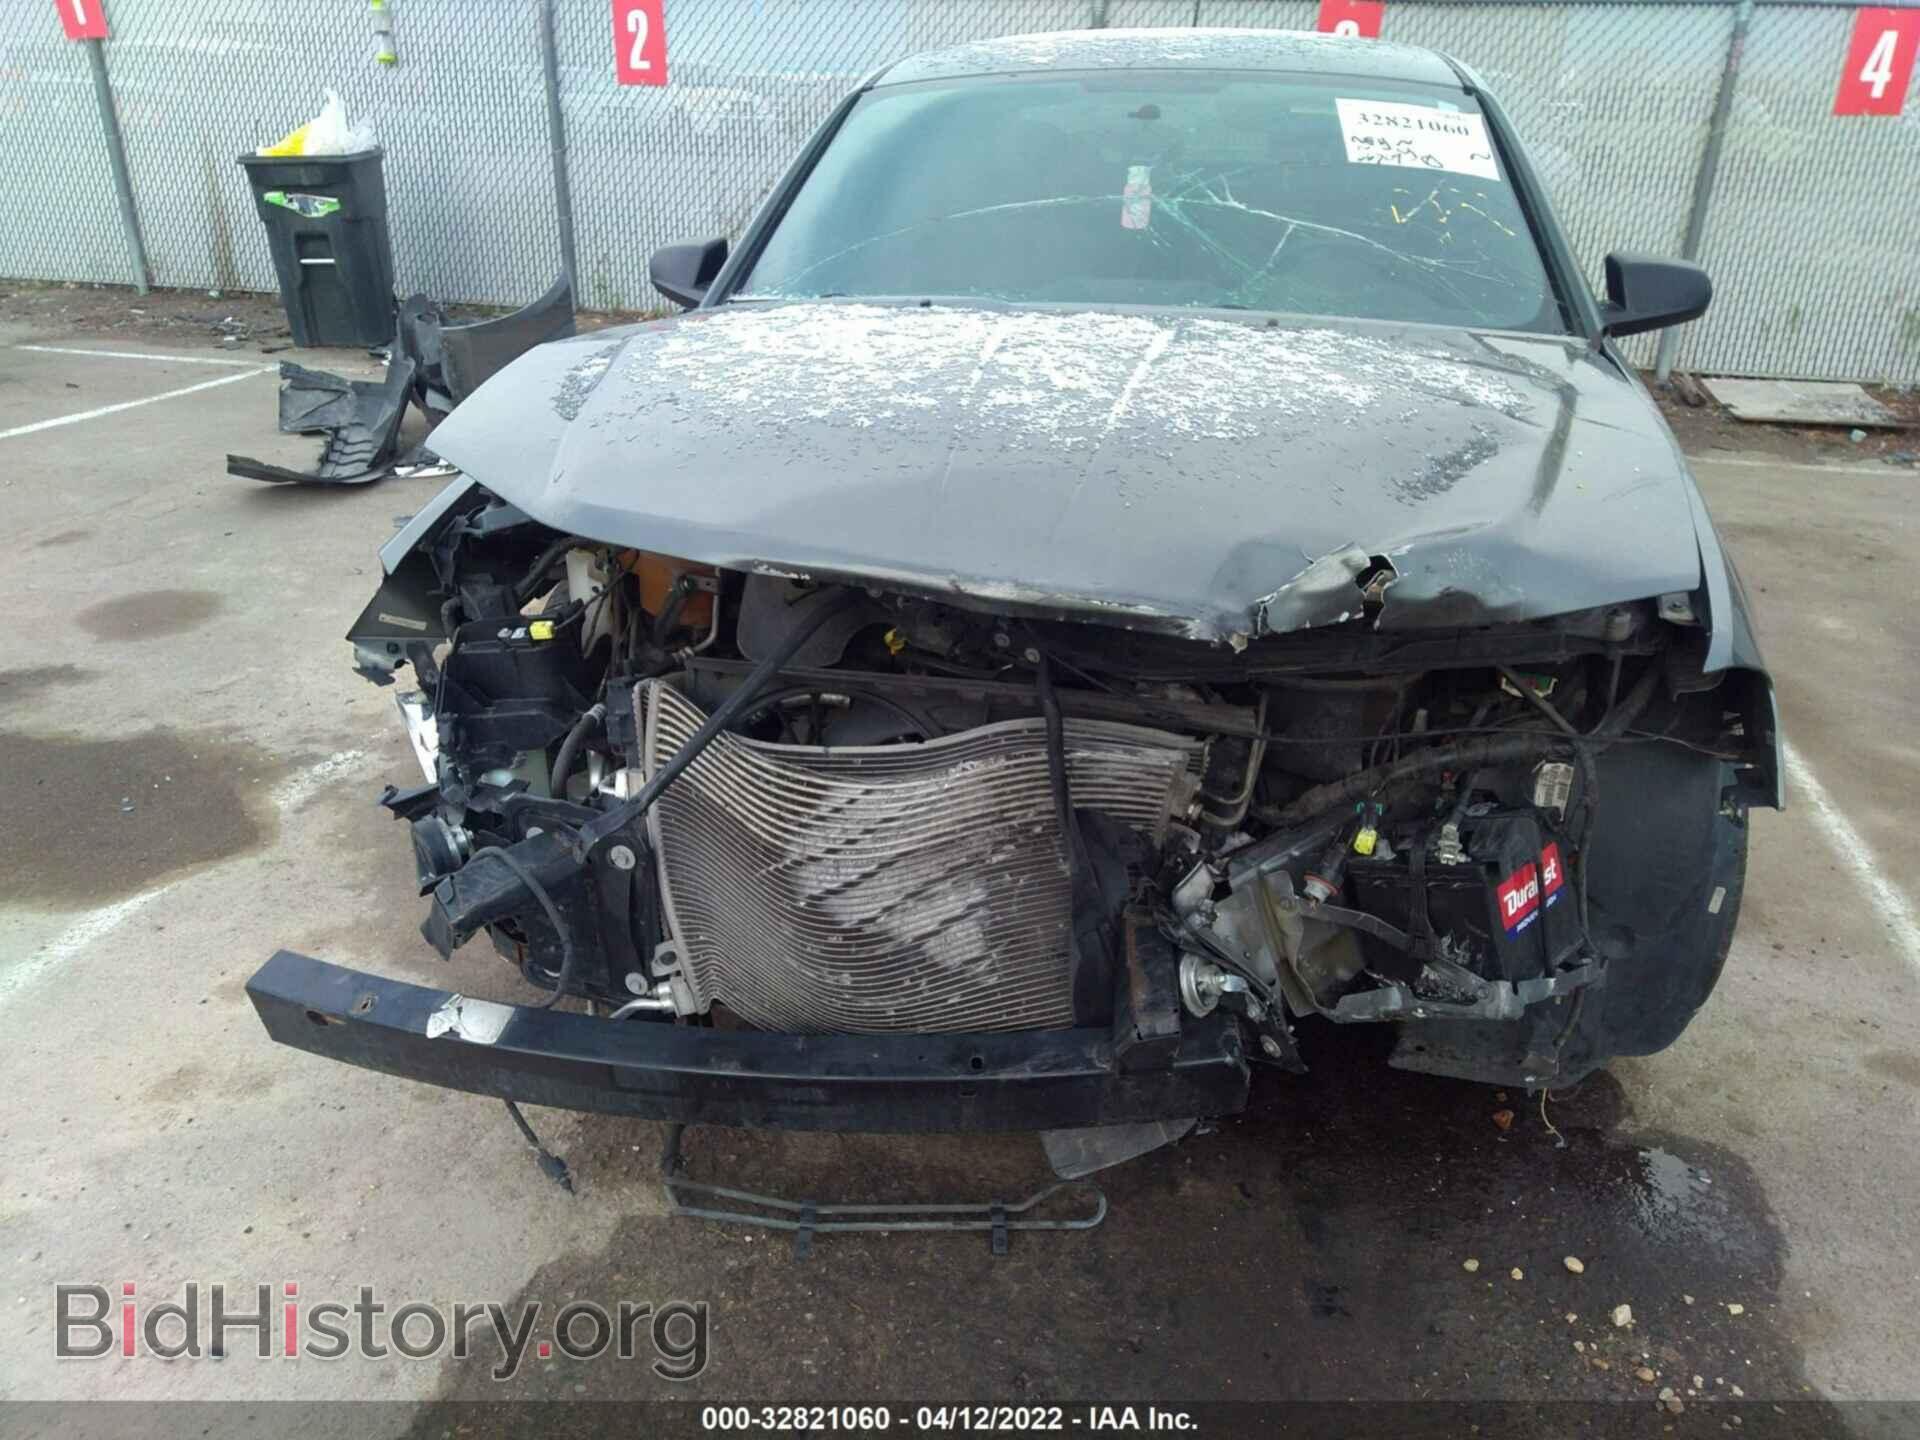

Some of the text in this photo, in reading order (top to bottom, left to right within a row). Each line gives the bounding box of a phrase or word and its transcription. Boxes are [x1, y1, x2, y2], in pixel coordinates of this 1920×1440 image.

[627, 9, 651, 70] 2
[1860, 30, 1898, 98] 4
[1503, 858, 1557, 916] Duralst
